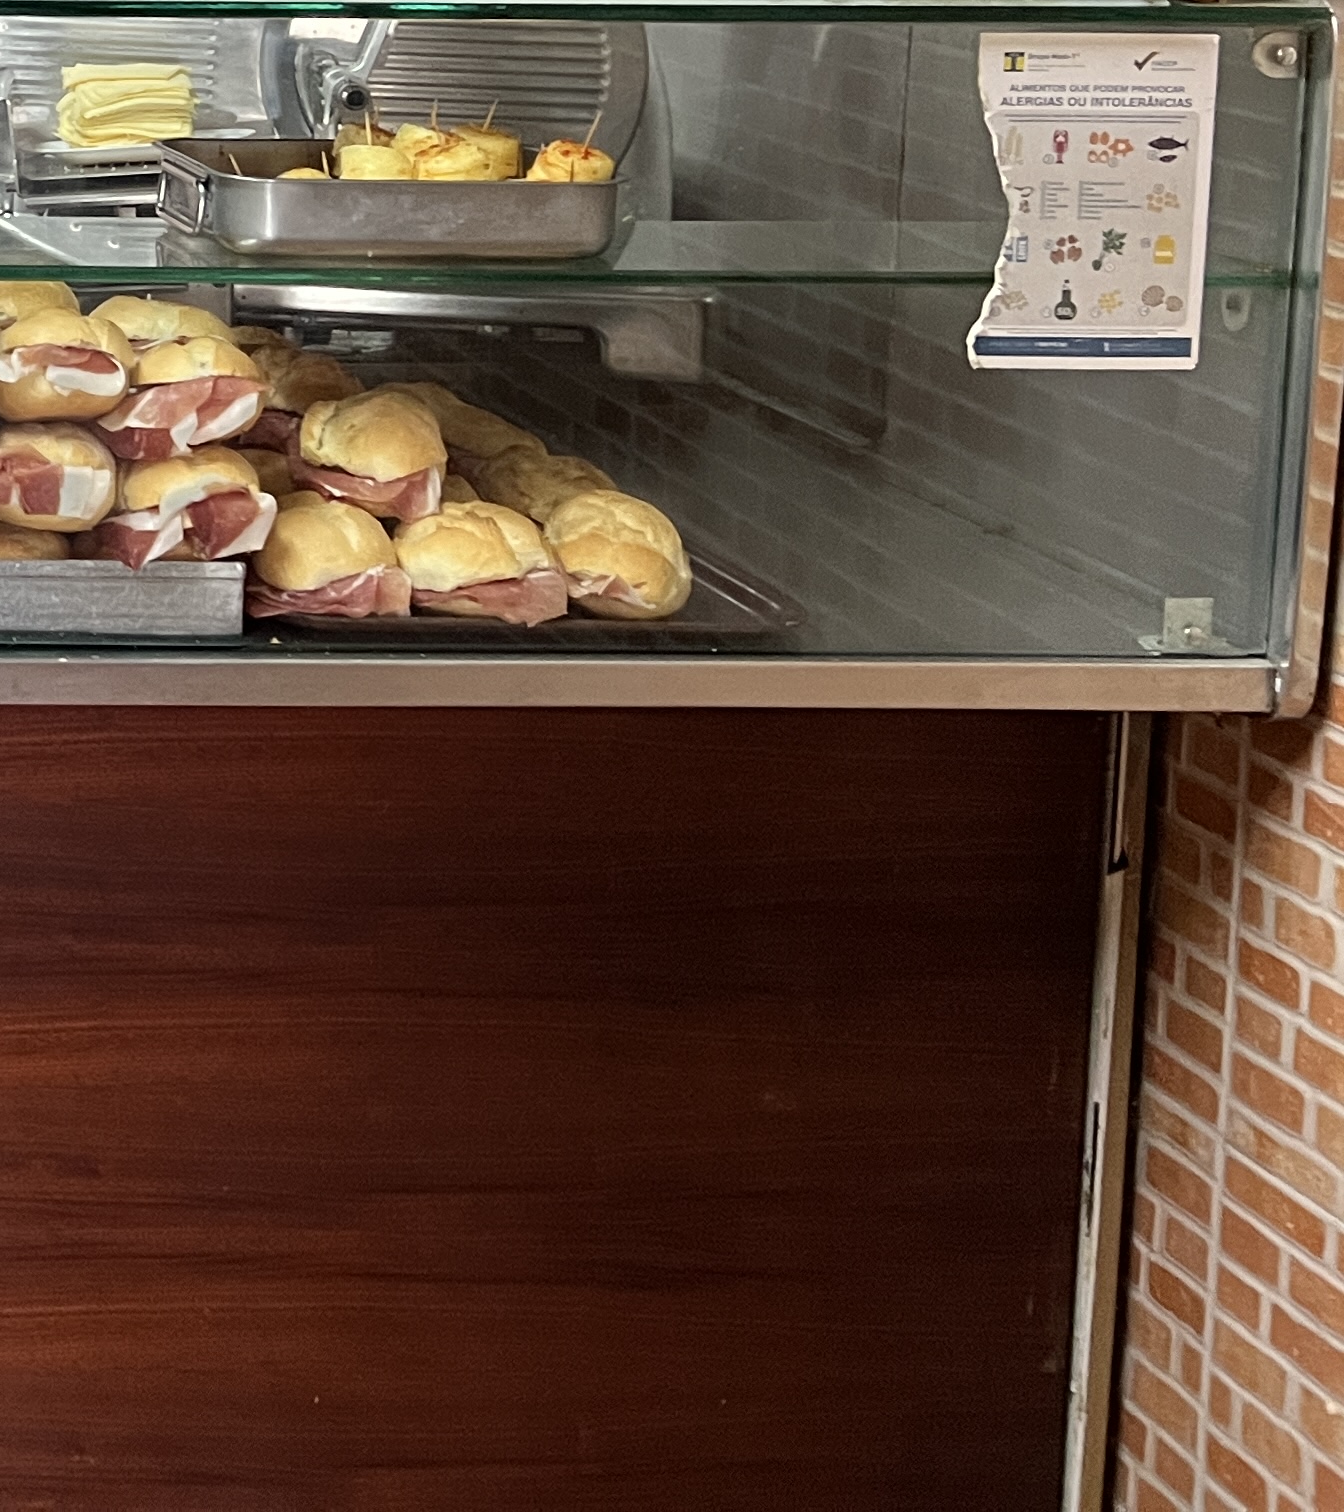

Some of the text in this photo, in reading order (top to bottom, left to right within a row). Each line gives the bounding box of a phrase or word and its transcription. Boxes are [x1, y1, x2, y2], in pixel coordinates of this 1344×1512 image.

[1069, 84, 1091, 94] QUE
[1093, 85, 1129, 94] PODEM
[1131, 85, 1186, 94] PROVOCAR
[1000, 95, 1193, 108] ALERGIAS OU INTOLERÂNCIAS
